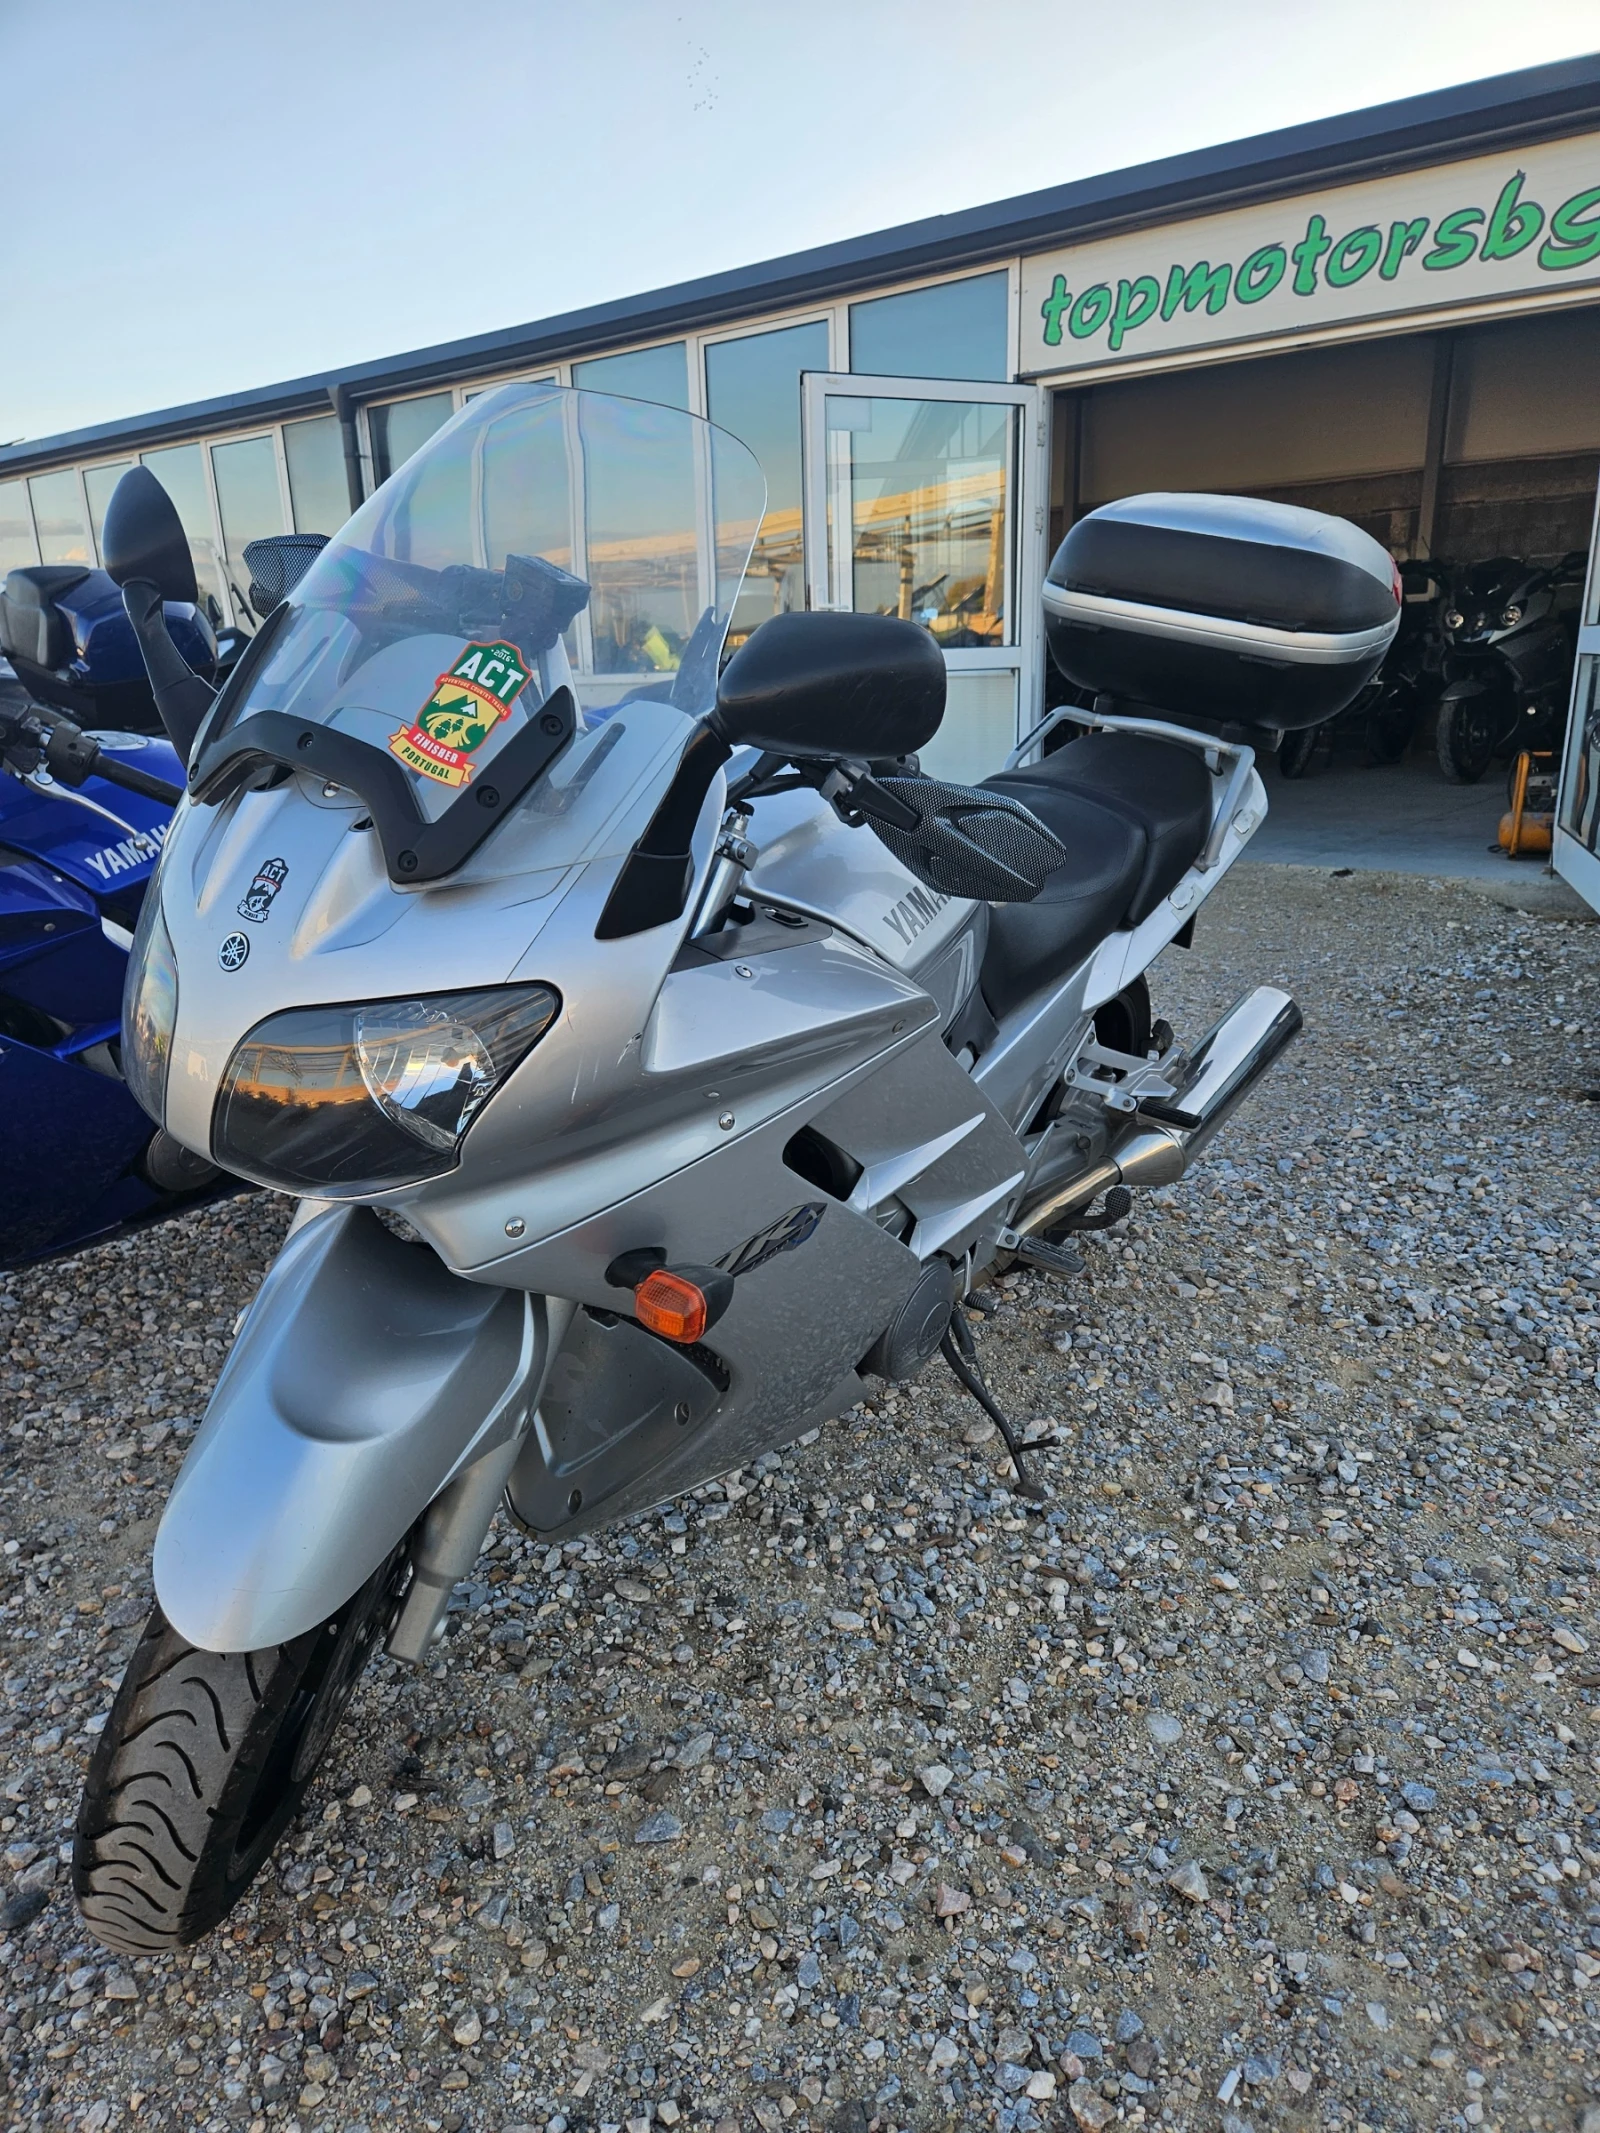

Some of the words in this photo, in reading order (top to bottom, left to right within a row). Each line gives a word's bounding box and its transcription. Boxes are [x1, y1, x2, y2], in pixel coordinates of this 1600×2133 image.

[493, 649, 512, 662] 2016
[453, 651, 524, 698] ACT
[401, 746, 450, 780] PORTUGAL
[413, 732, 459, 764] FINISHER
[84, 820, 171, 880] YAMAH
[260, 864, 286, 882] ACT
